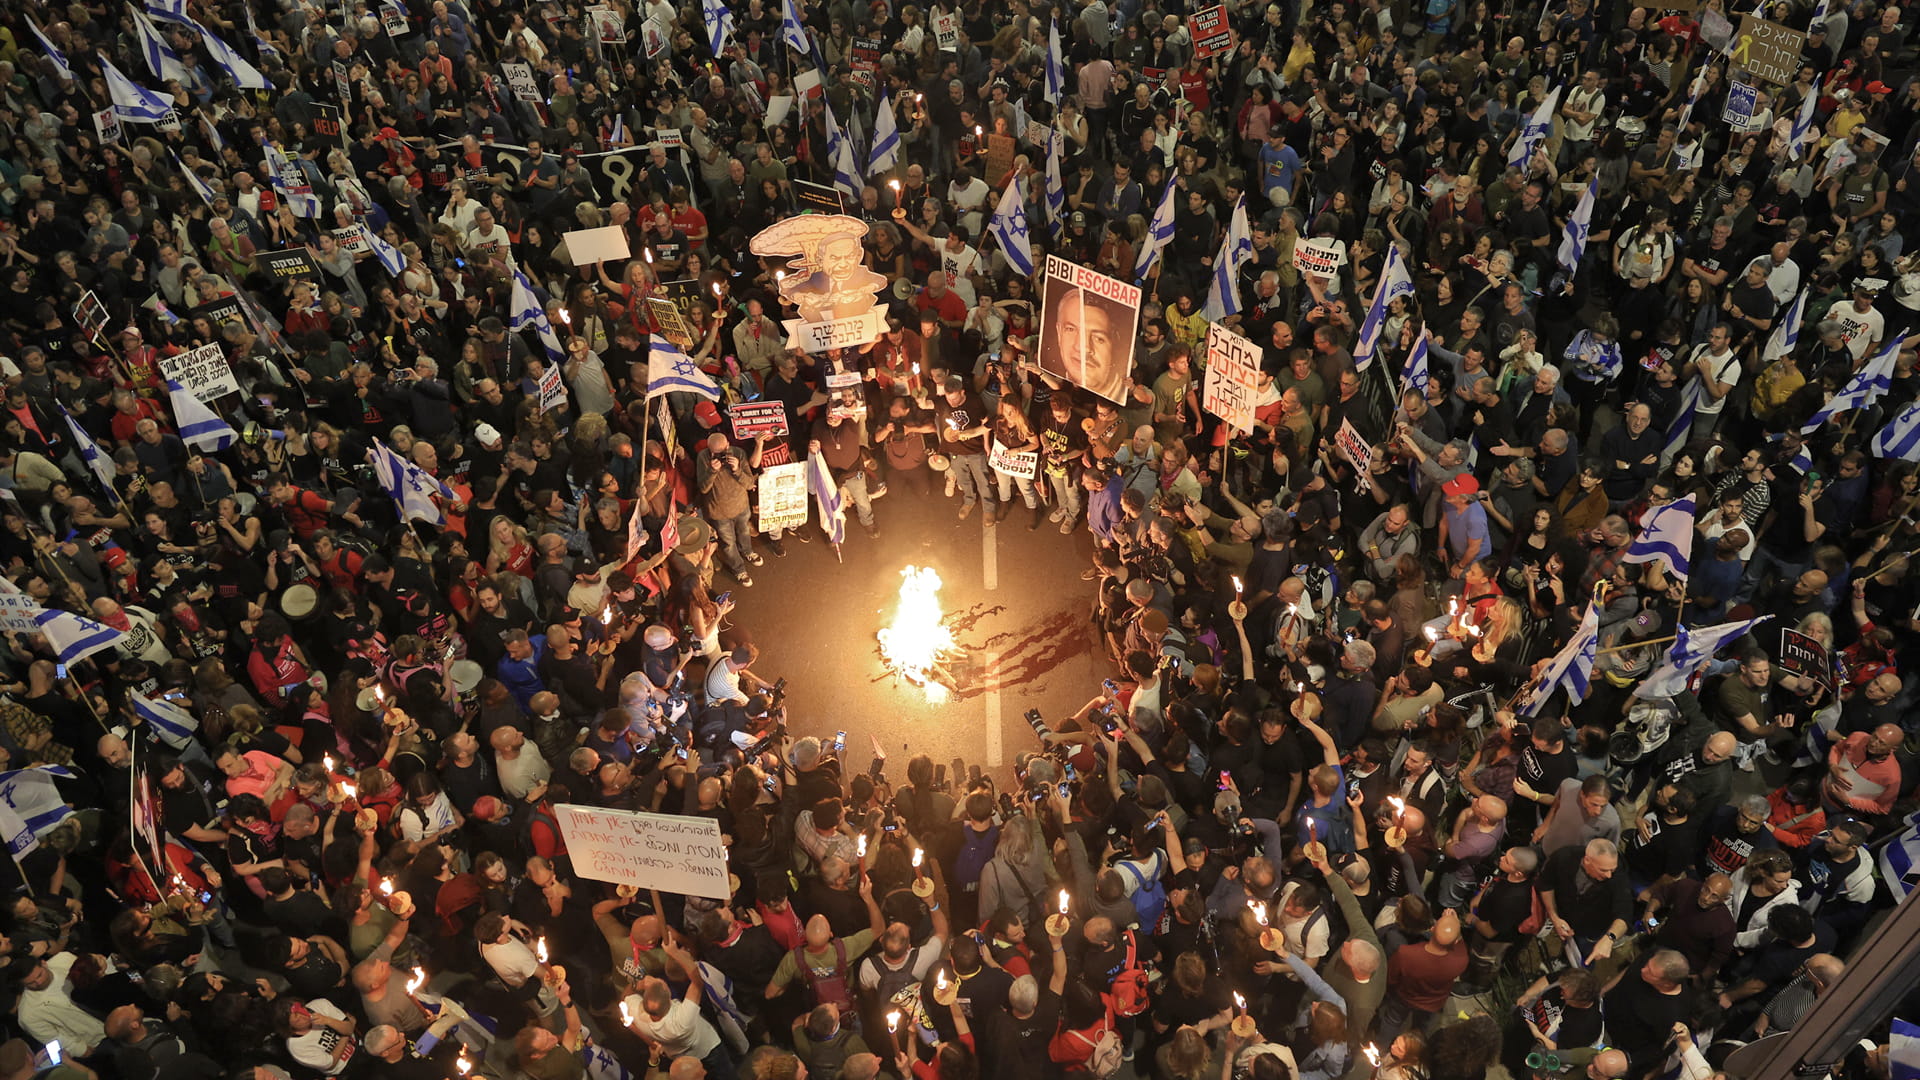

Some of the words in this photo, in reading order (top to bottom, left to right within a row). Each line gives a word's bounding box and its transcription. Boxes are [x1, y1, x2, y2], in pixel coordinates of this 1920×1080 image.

[1751, 22, 1772, 38] לא
[1773, 30, 1801, 49] הוא
[1759, 42, 1796, 65] יחזיר
[313, 118, 340, 136] HELP
[270, 257, 303, 269] עסקה
[1295, 248, 1331, 266] המכשול
[1305, 247, 1340, 261] נתניהו
[1299, 259, 1336, 274] לעסקה
[1047, 257, 1074, 282] BIBI
[1076, 269, 1139, 306] ESCOBAR
[812, 320, 864, 337] מורשת
[816, 331, 863, 347] נתניהו
[1229, 334, 1244, 347] הוא
[1211, 328, 1257, 371] מחבל
[1216, 387, 1251, 415] אותנו
[752, 416, 783, 425] KIDNAPPED
[1341, 428, 1365, 461] המכשול
[1349, 430, 1371, 459] נתניהו
[763, 447, 788, 466] STOP
[993, 449, 1028, 467] המכשול
[1345, 441, 1367, 471] לעסקה
[997, 460, 1034, 474] לעסקה
[1788, 644, 1815, 661] יחזרו
[685, 845, 722, 859] מסית
[594, 860, 636, 878] מוחלט
[679, 860, 723, 877] הממשלה
